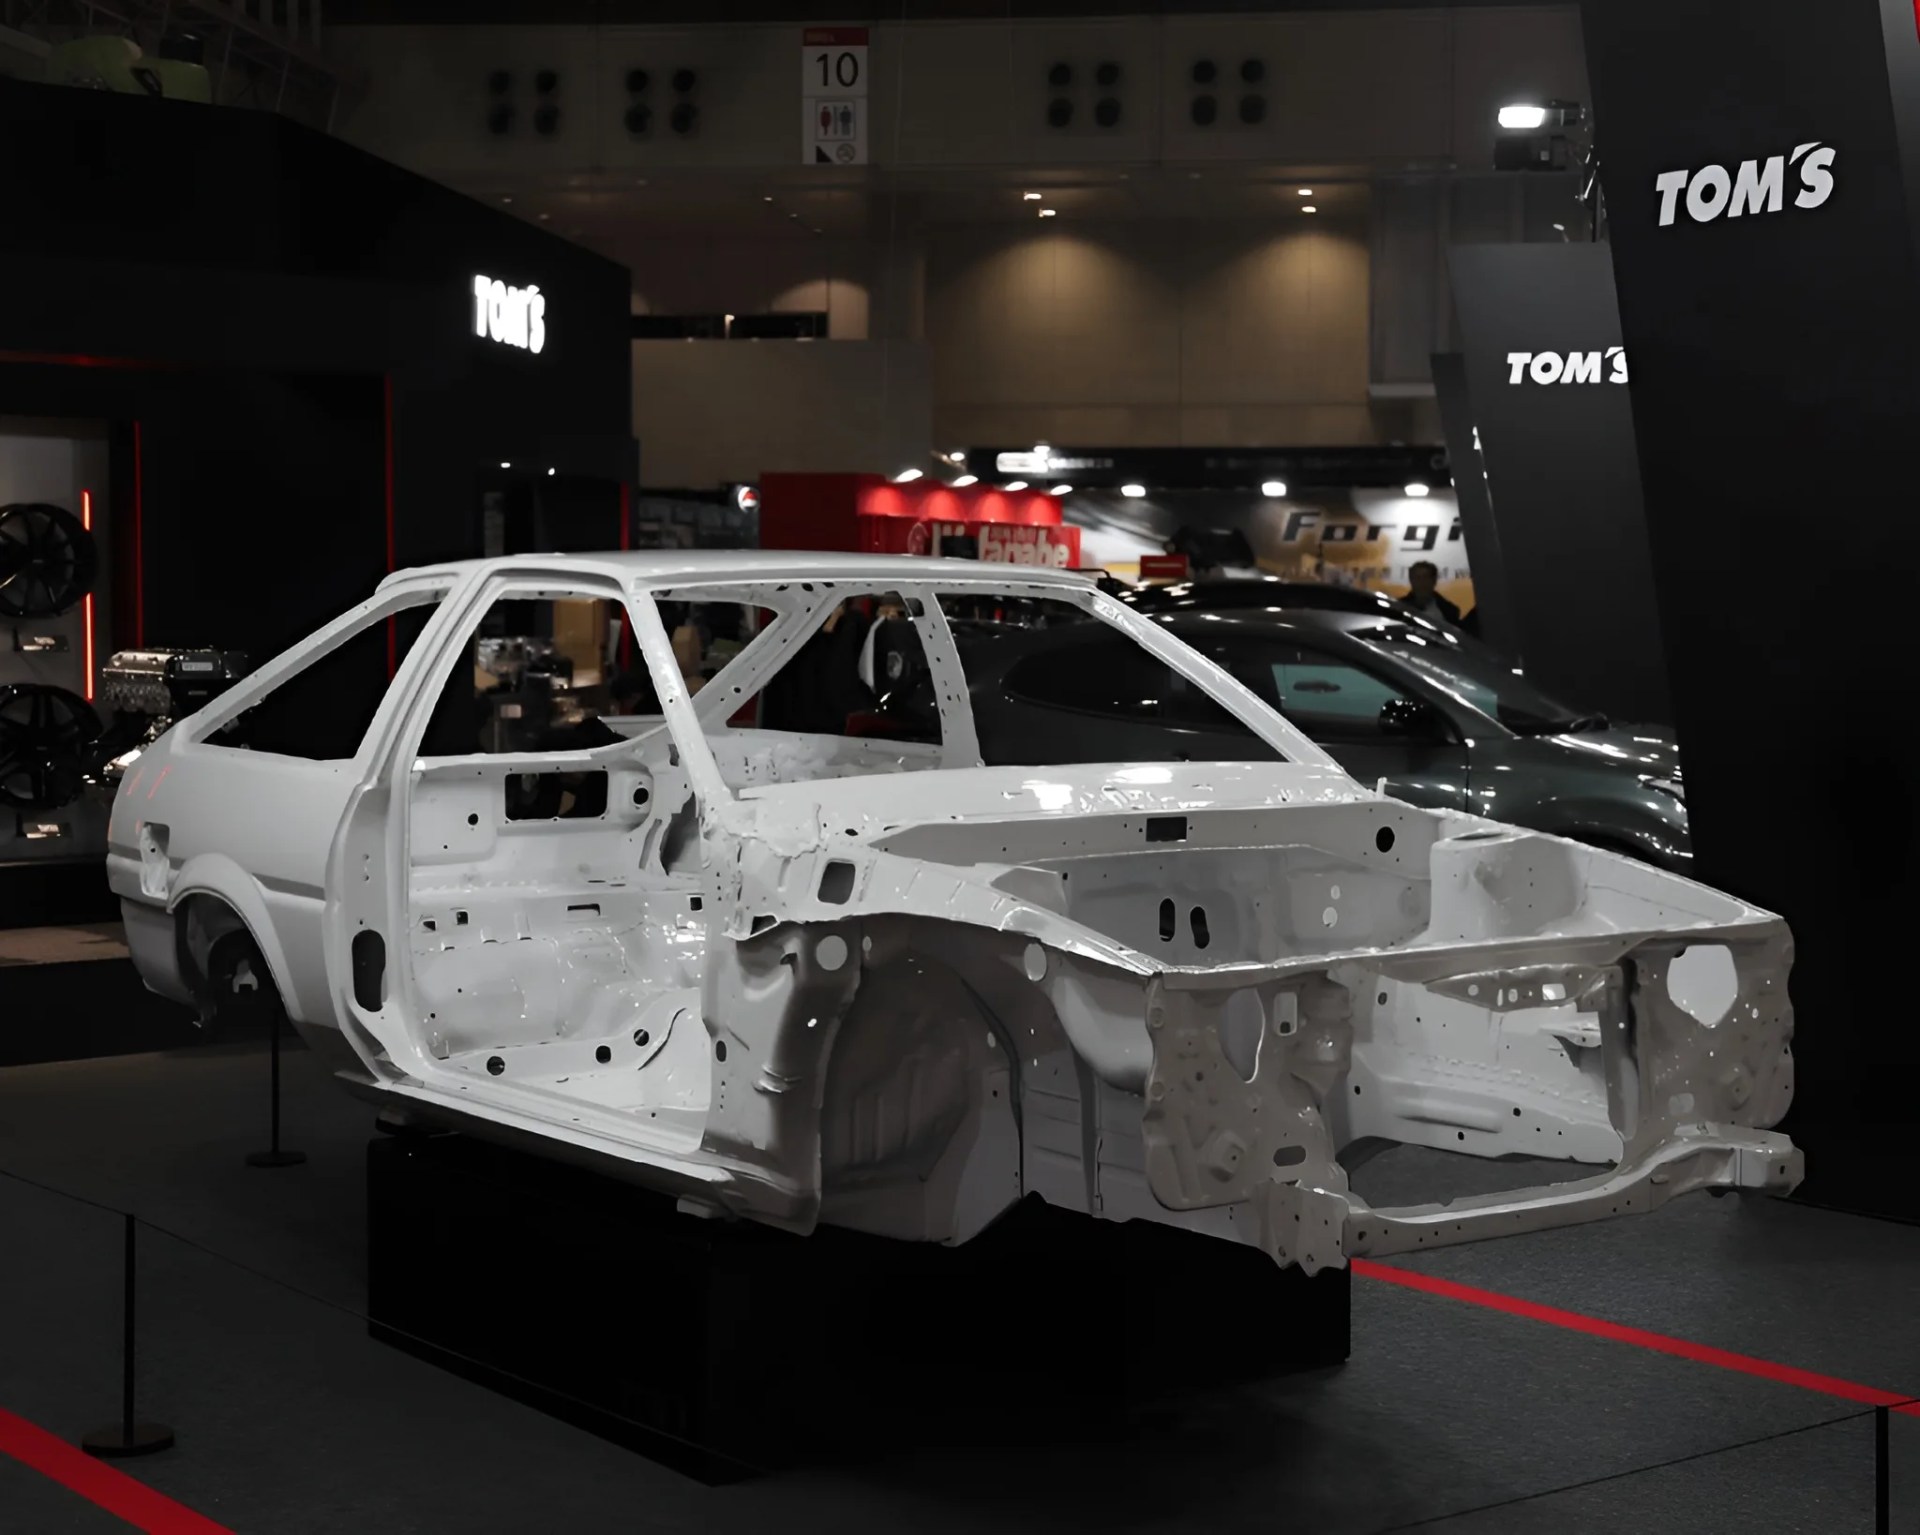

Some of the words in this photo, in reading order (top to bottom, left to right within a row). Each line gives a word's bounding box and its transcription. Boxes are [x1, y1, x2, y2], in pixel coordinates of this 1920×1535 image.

[816, 52, 859, 87] 10
[1655, 141, 1837, 227] TOM'S
[474, 274, 546, 354] TOM'S
[1507, 346, 1629, 385] TOM'S
